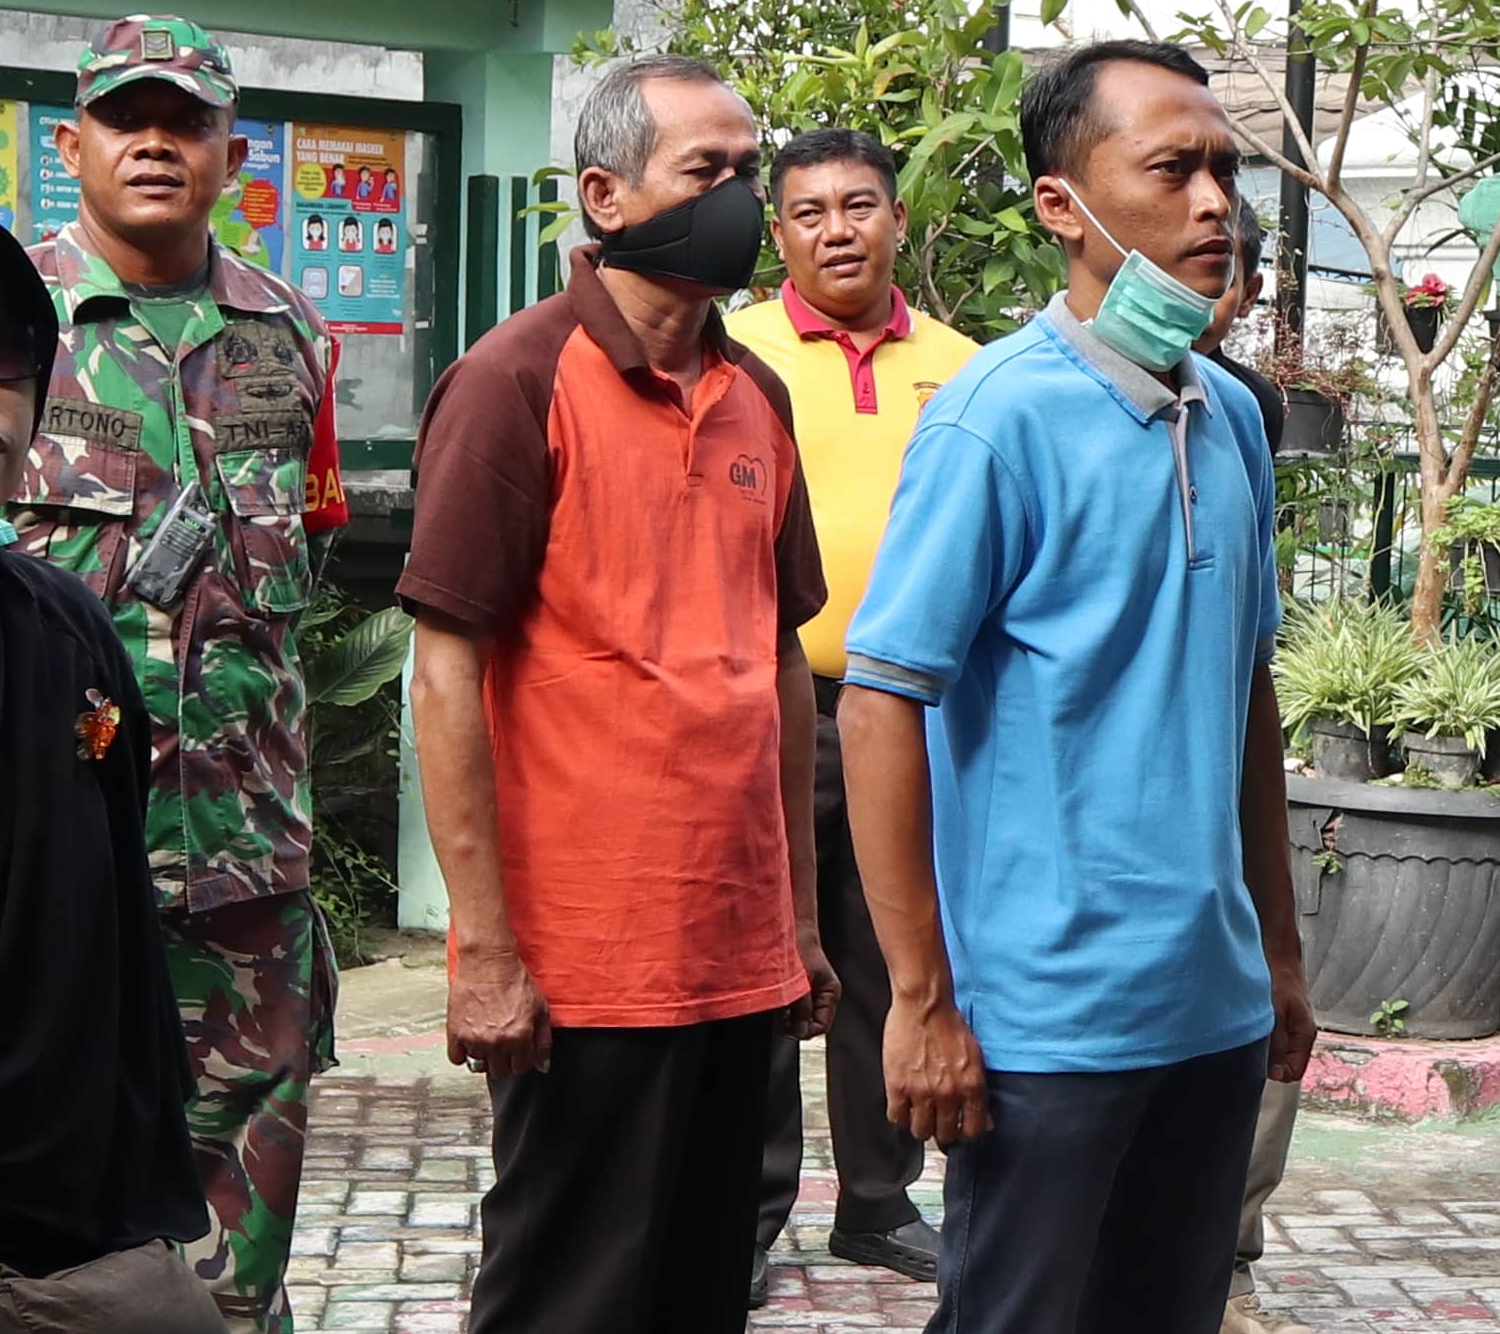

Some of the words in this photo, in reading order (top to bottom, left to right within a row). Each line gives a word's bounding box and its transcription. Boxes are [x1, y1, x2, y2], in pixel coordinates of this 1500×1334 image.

[296, 138, 317, 150] CARA
[355, 142, 384, 155] MASKER
[43, 405, 125, 438] RTONO
[304, 468, 346, 511] BA
[729, 461, 757, 490] GM
